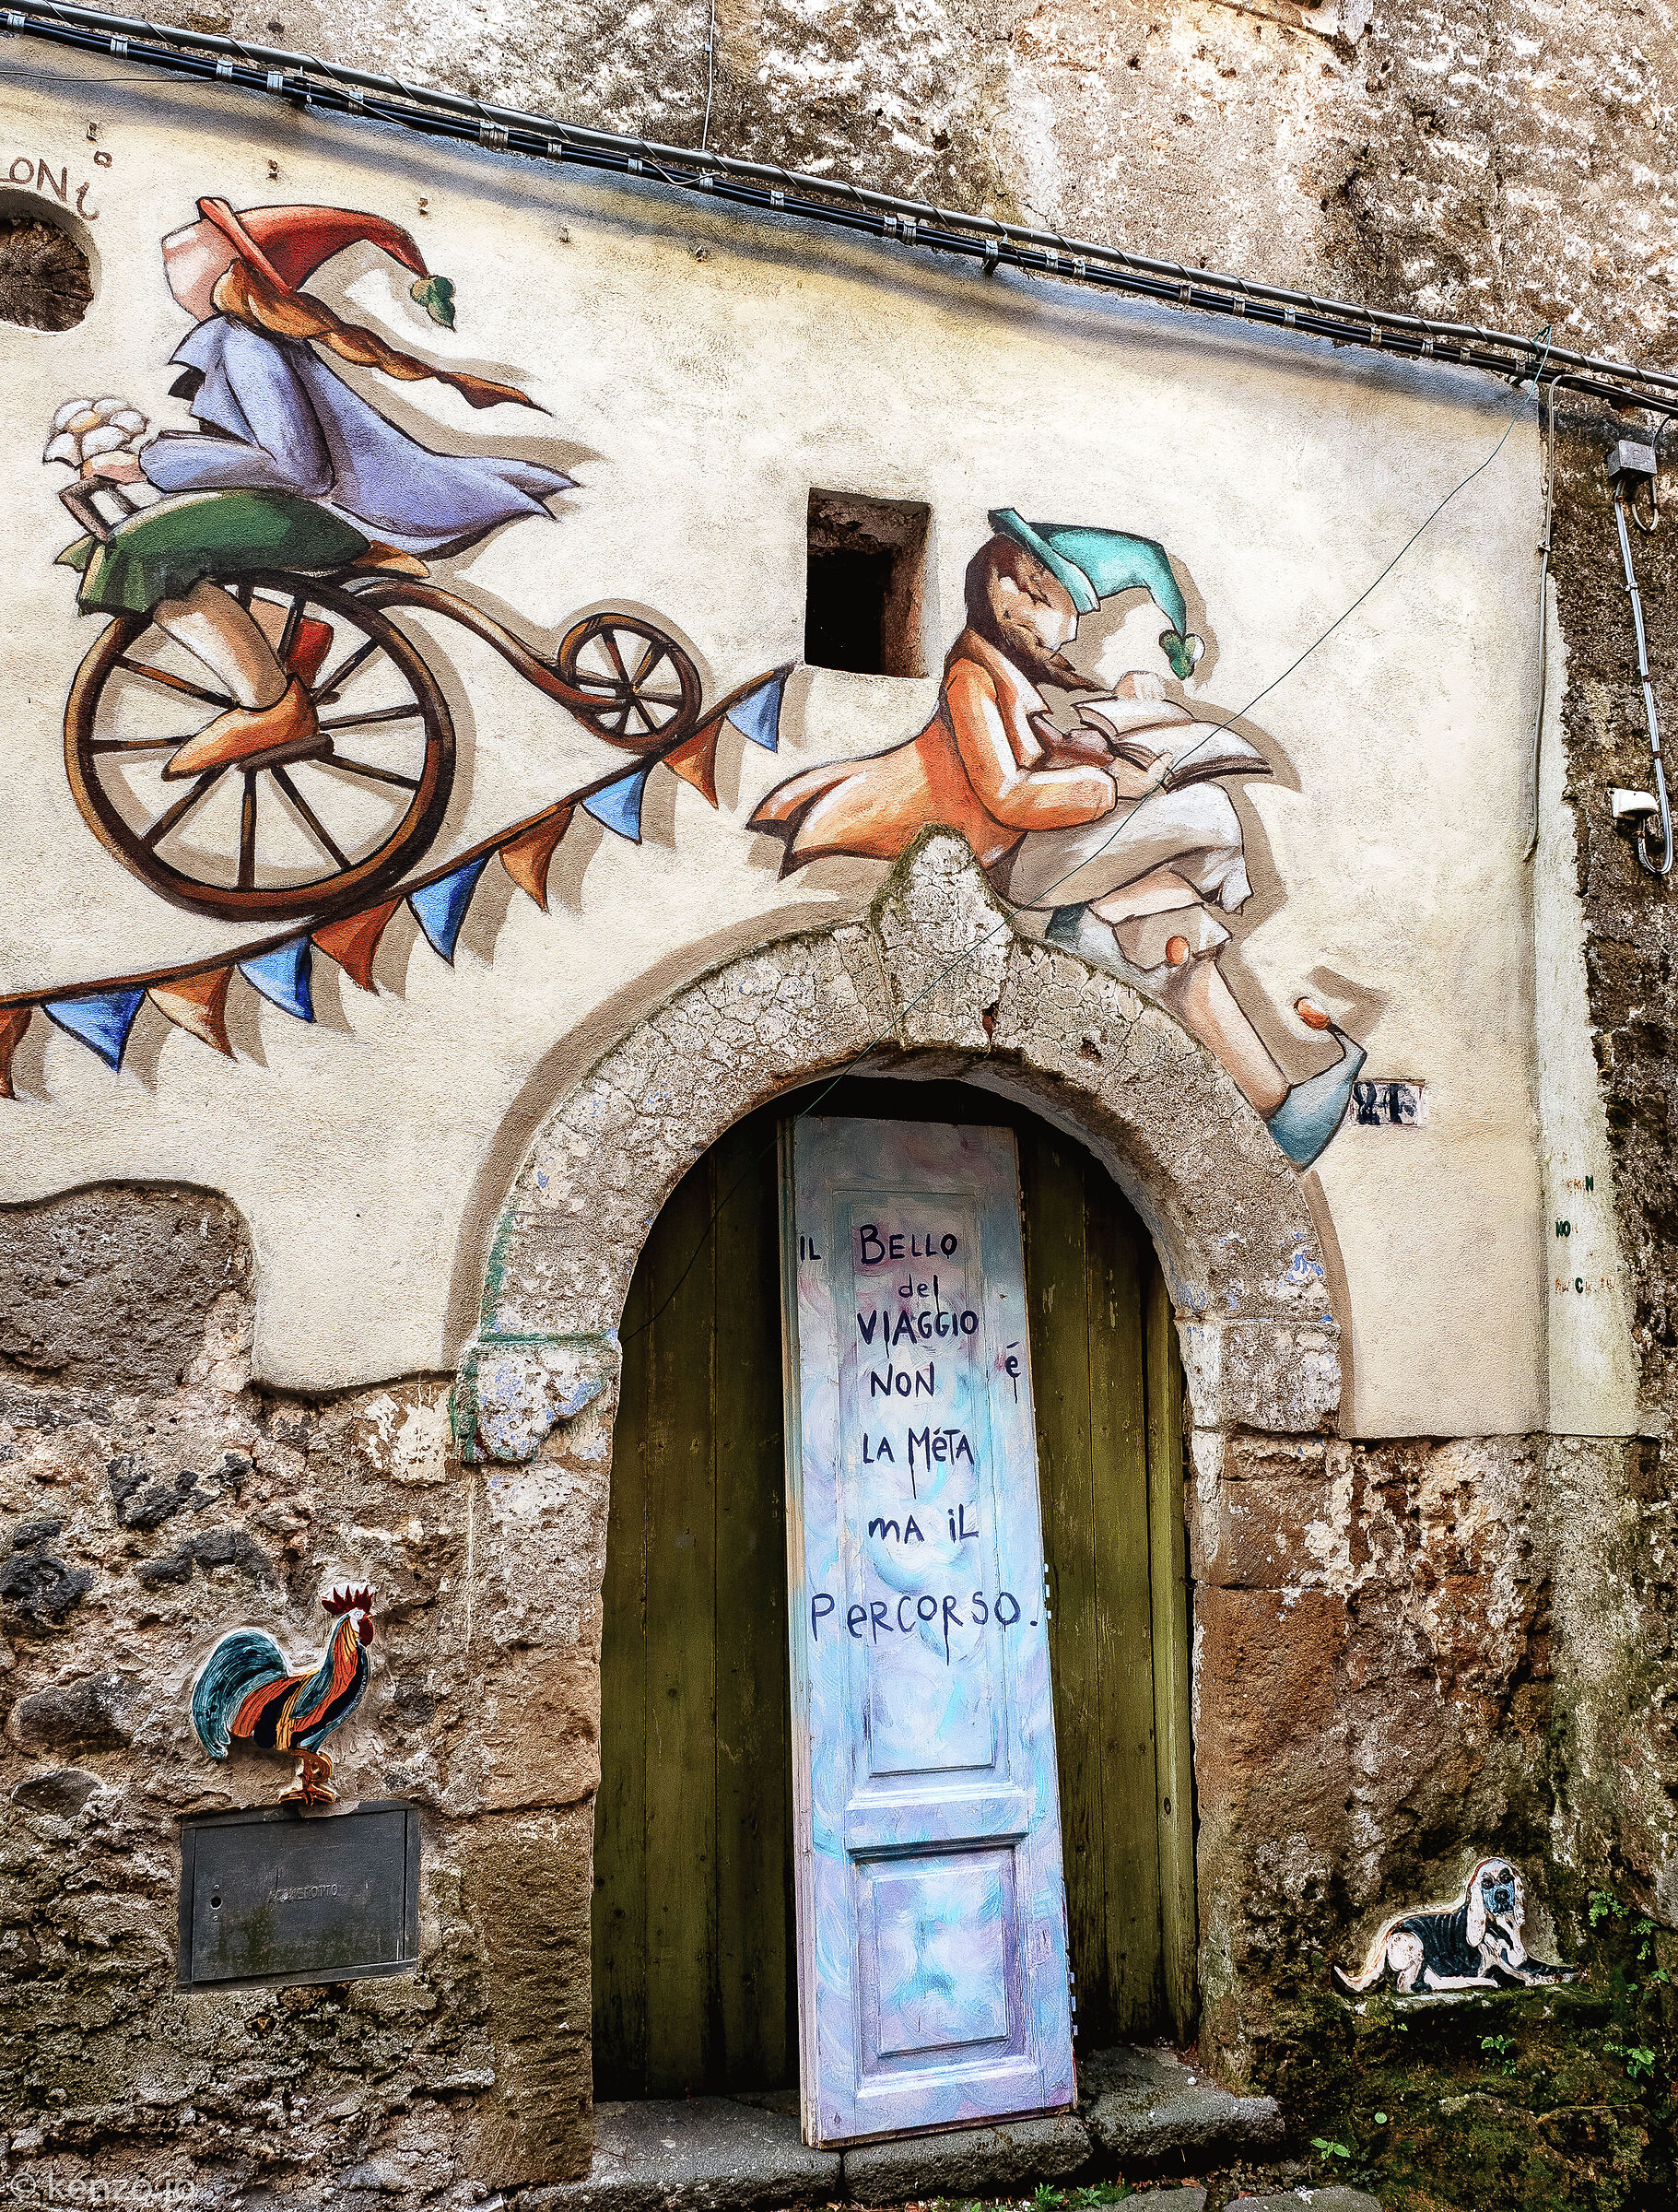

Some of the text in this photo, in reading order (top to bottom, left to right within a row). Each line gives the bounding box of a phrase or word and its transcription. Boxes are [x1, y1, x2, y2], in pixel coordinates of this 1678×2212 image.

[800, 1224, 958, 1265] IL BELLO
[898, 1274, 940, 1301] del
[857, 1310, 979, 1347] VIAGGIO
[871, 1361, 935, 1397] NON
[862, 1432, 896, 1464] LA
